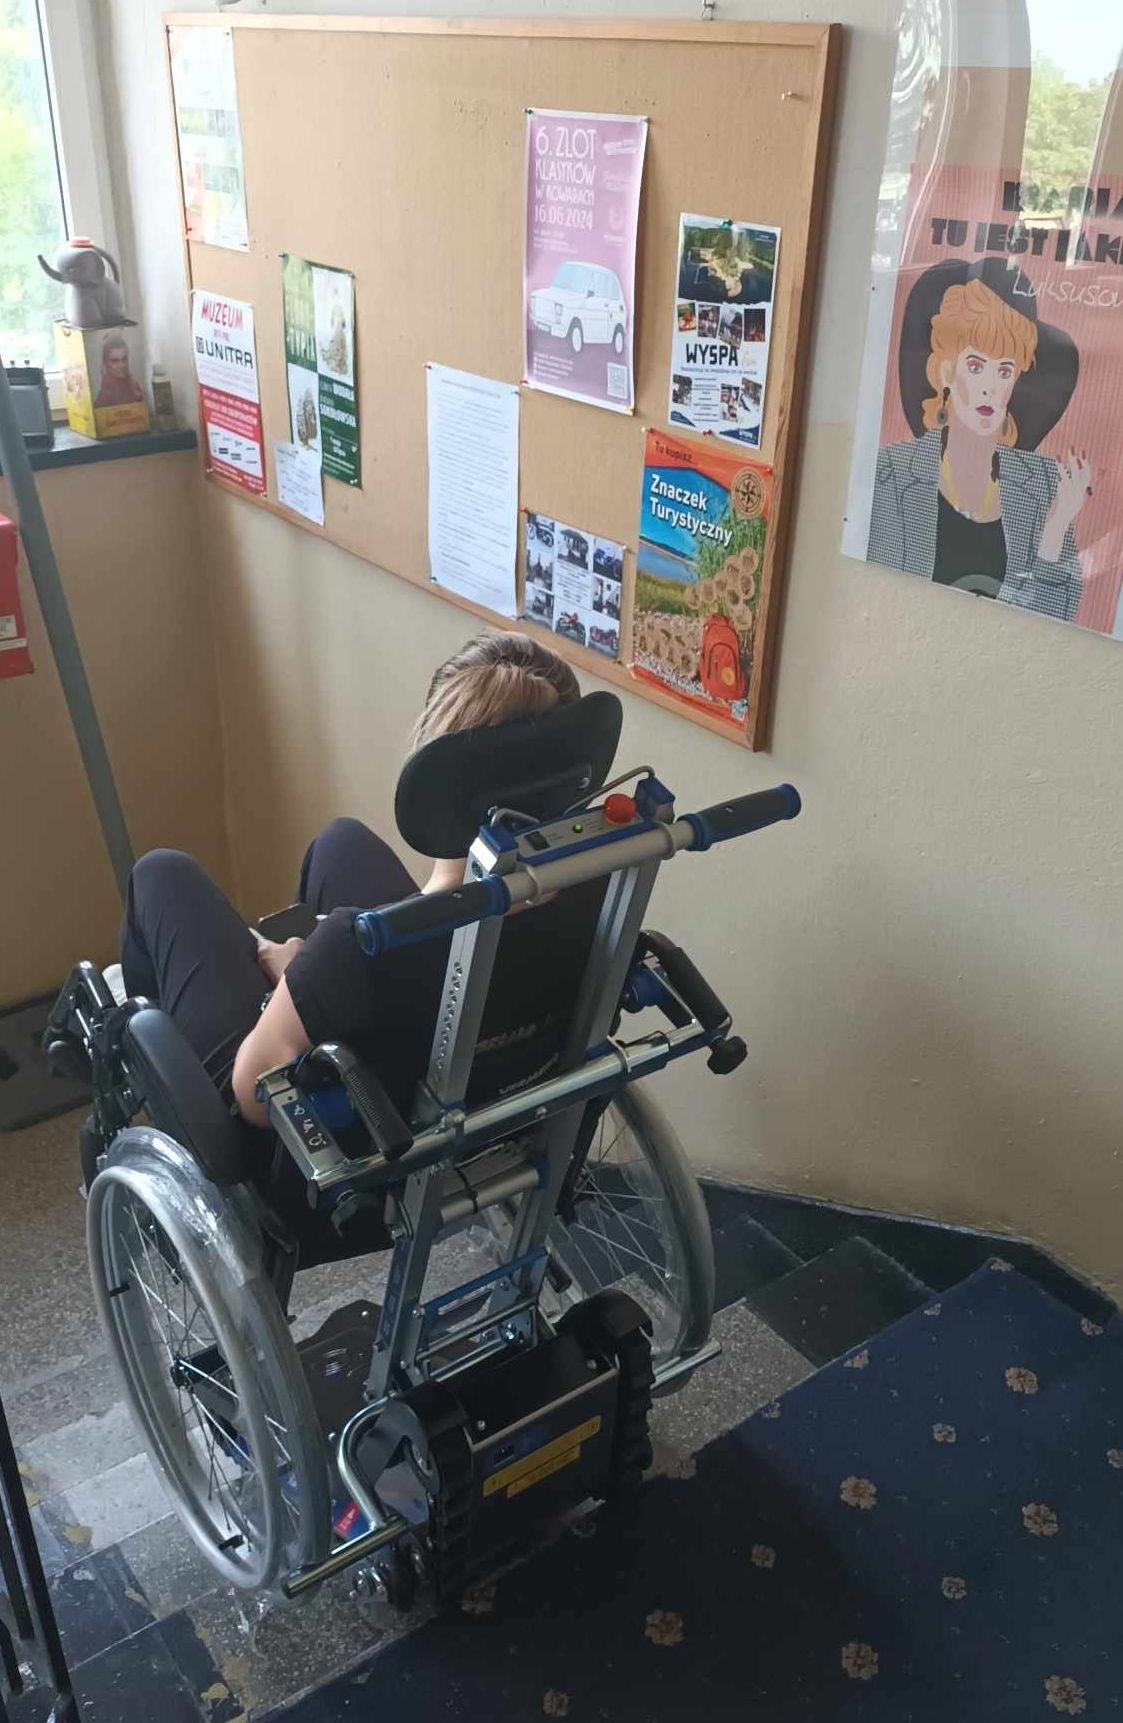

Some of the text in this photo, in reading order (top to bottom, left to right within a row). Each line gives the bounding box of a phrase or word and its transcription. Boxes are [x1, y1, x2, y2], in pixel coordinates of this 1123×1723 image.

[535, 125, 552, 156] 6.
[555, 126, 597, 160] ZLOT
[931, 217, 969, 247] TU
[1054, 228, 1123, 265] JAK
[201, 299, 243, 331] MUZEUM
[205, 339, 254, 369] UNITRA
[685, 343, 738, 366] WYSPA
[655, 441, 664, 454] Tu
[650, 473, 708, 511] Znaczek
[649, 496, 733, 547] Turystyczny
